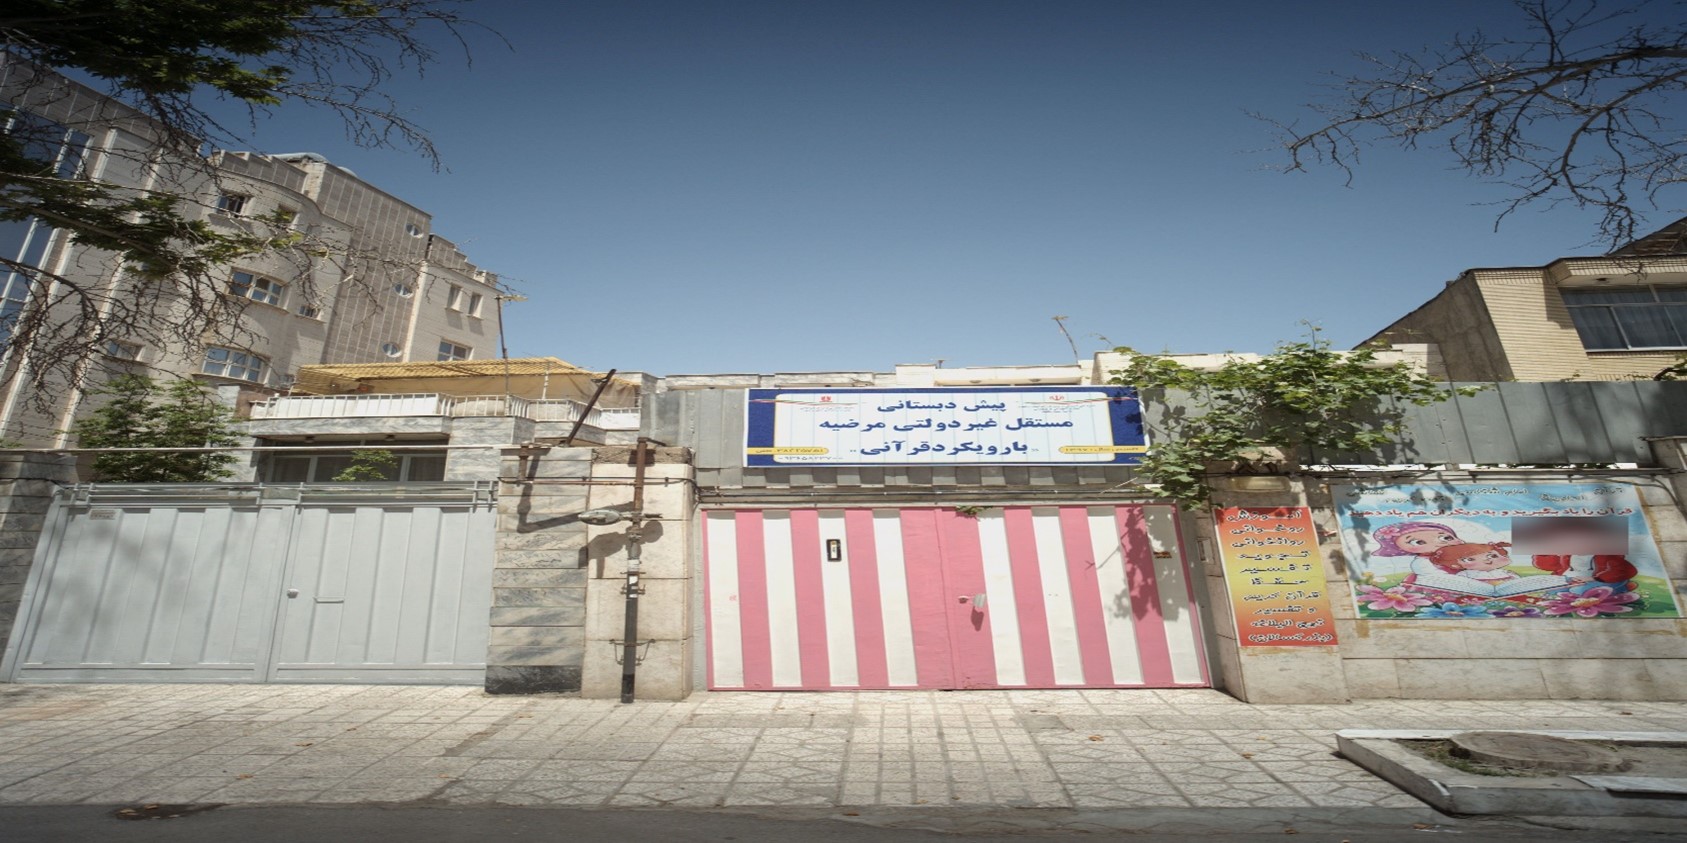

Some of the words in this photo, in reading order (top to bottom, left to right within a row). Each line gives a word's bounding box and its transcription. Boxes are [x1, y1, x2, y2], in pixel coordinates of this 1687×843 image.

[877, 400, 957, 413] دبستانی
[963, 399, 1006, 412] پیش
[819, 418, 886, 432] مرضیه
[1005, 417, 1074, 431] مستقل
[1385, 508, 1404, 516] یاد
[1406, 509, 1427, 517] هم
[1431, 507, 1481, 517] دیگران
[1512, 507, 1560, 516] بگیرید
[1562, 507, 1580, 516] یاد
[1582, 507, 1594, 516] را
[1597, 507, 1634, 516] قرآن
